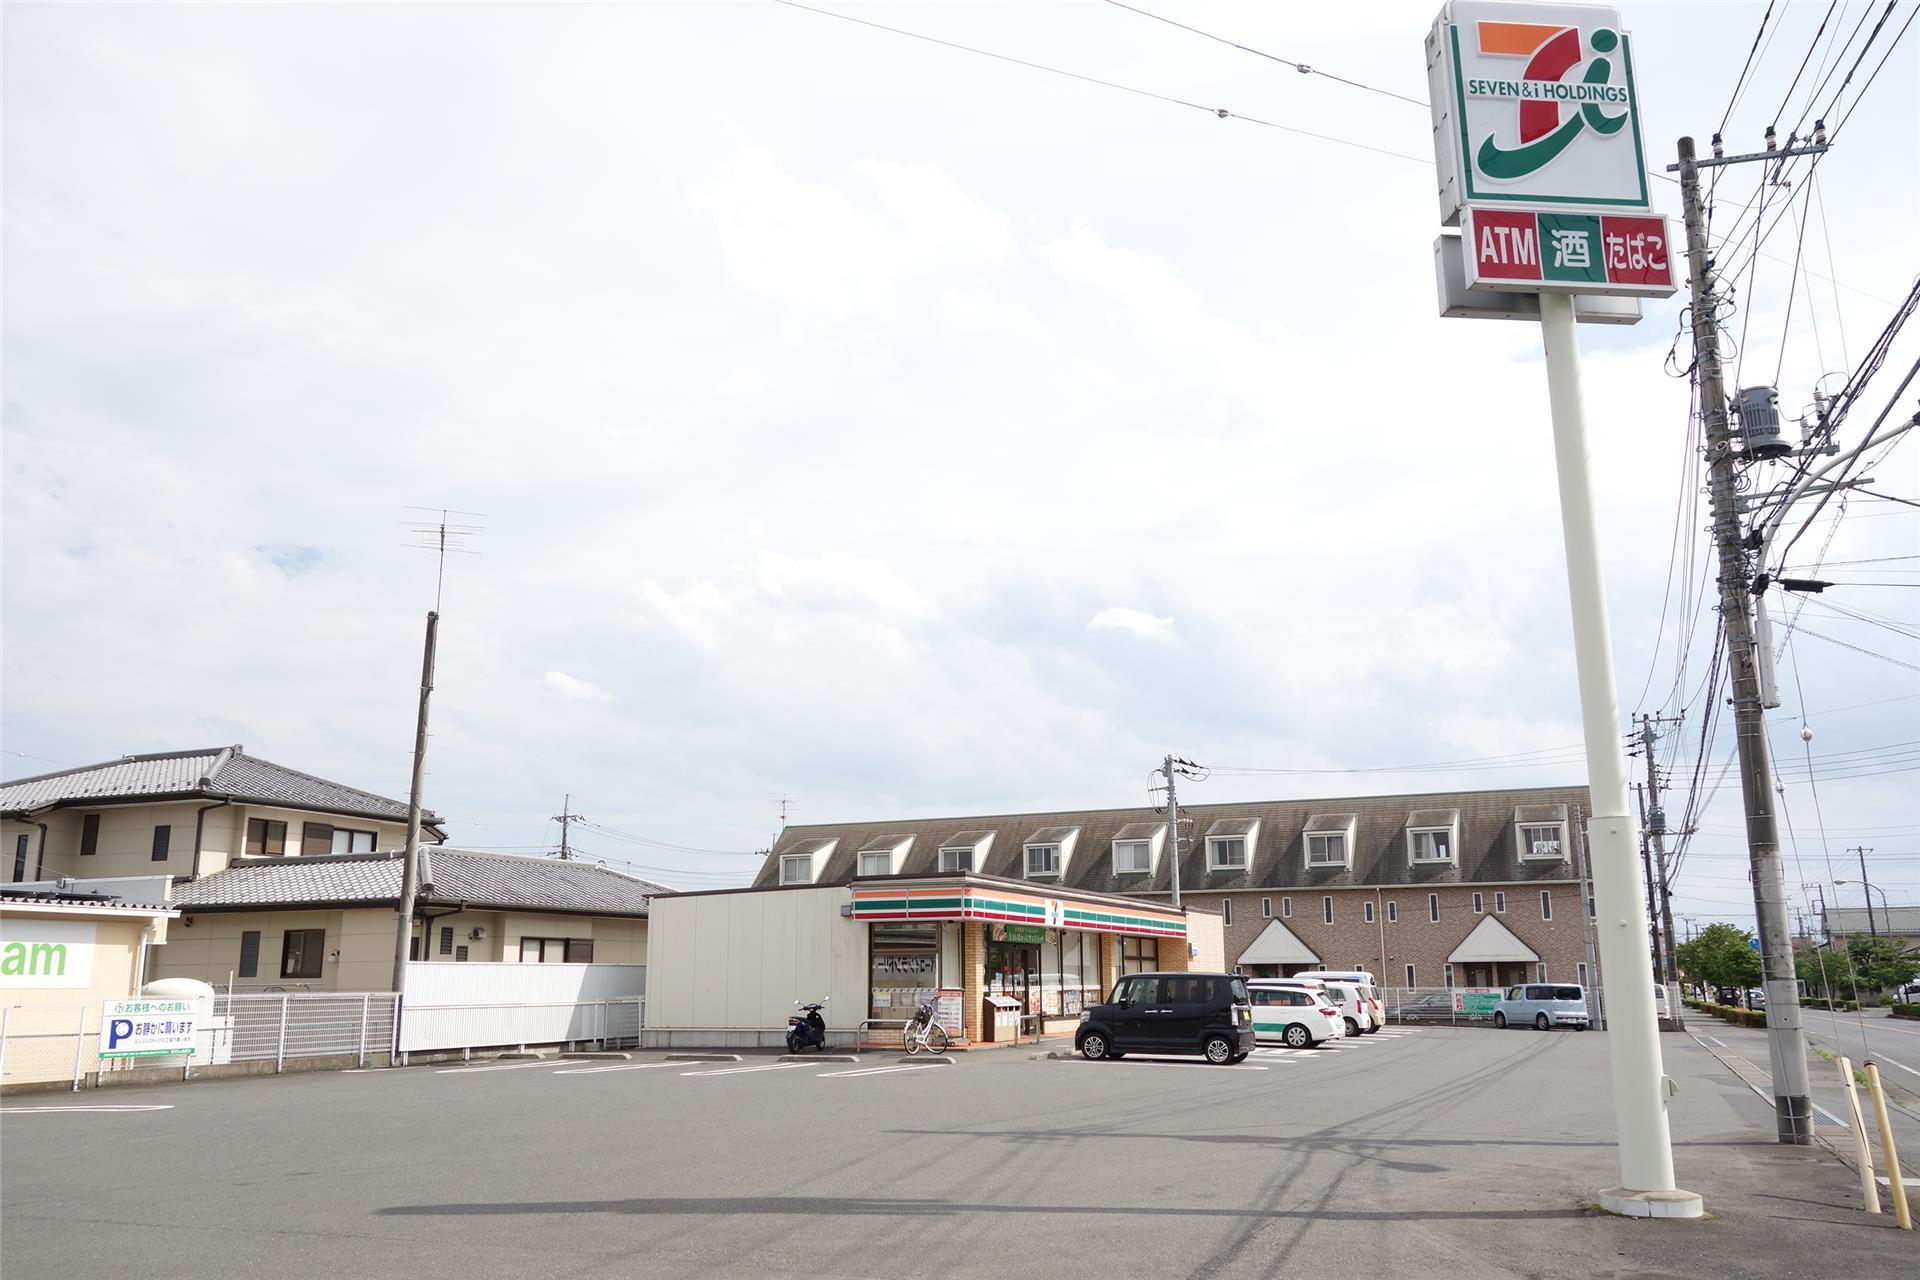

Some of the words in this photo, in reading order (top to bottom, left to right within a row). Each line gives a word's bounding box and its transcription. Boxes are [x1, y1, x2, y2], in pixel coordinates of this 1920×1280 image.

[1544, 83, 1628, 102] HOLDINGS
[1480, 225, 1537, 266] ATM
[1551, 229, 1590, 268] 酒
[1606, 231, 1667, 270] たばこ
[1, 942, 67, 976] am
[125, 1003, 190, 1012] お客様へのお願い
[135, 1021, 193, 1035] お静かに願います
